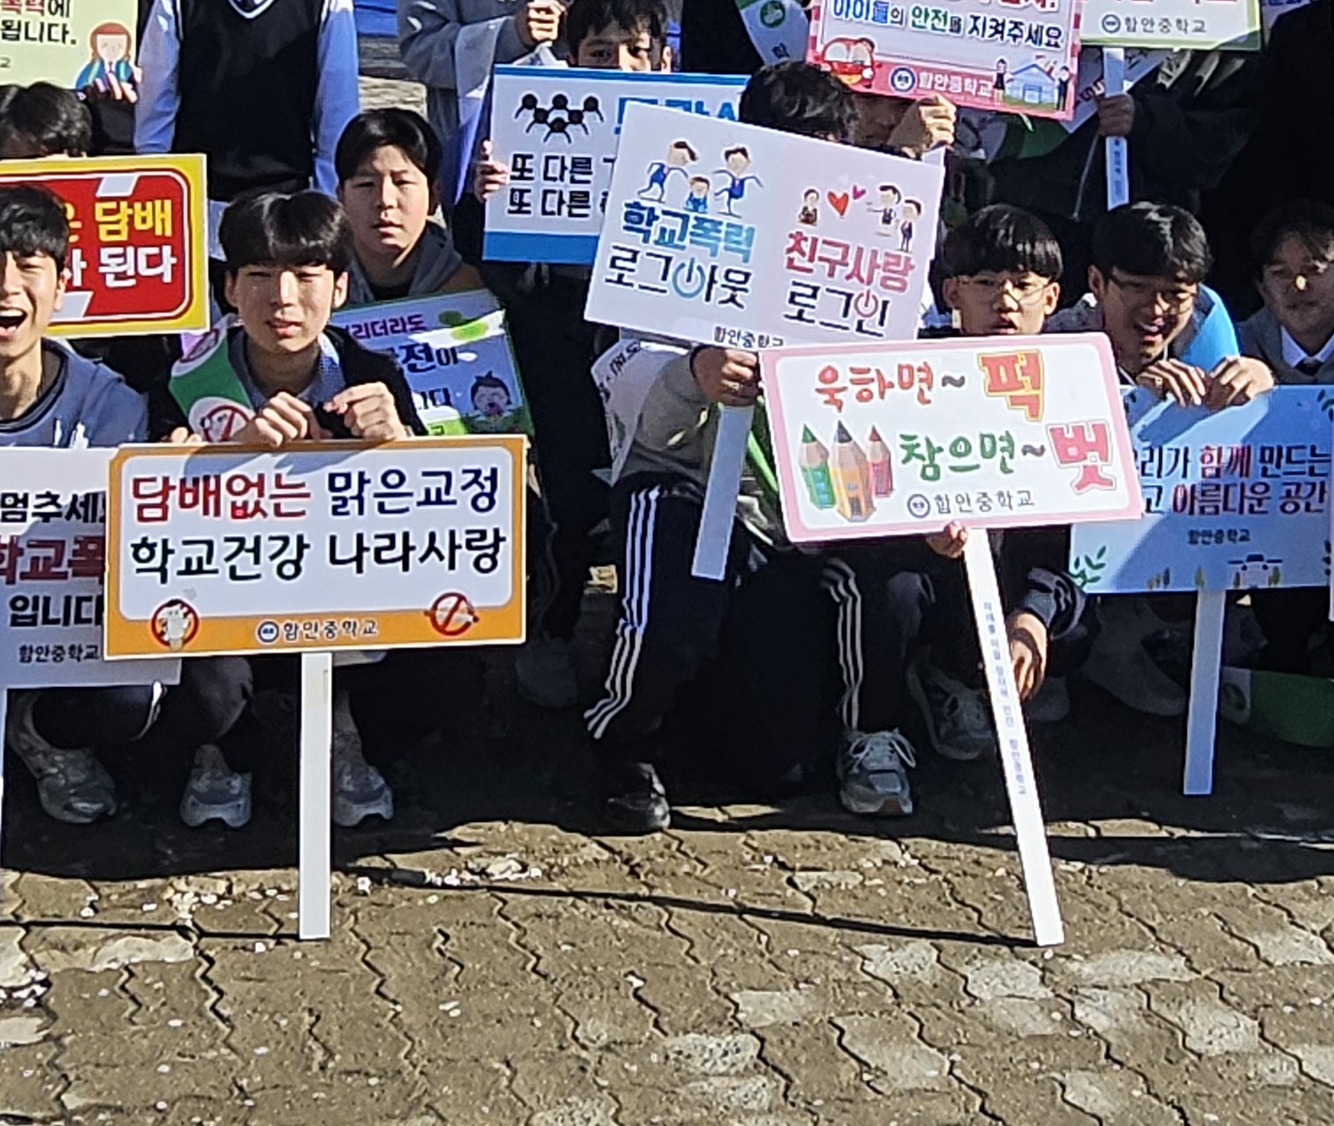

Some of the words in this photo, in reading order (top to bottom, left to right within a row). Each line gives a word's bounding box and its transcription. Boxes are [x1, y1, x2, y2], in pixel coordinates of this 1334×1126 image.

[968, 15, 1063, 50] 지켜주세요
[1125, 16, 1207, 35] 함안중학교
[918, 70, 994, 97] 함안중학교
[510, 153, 535, 182] 또
[543, 154, 594, 184] 다른
[94, 198, 173, 242] 담배
[507, 188, 532, 215] 또
[541, 189, 591, 218] 다른
[622, 200, 756, 264] 학교폭력
[97, 245, 177, 287] 된다
[604, 245, 753, 310] 로그아웃
[785, 230, 915, 294] 친구사랑
[346, 312, 427, 338] 리더라도
[782, 279, 891, 338] 로그인
[980, 351, 1043, 420] 퍽
[1048, 420, 1115, 492] 벗
[1199, 445, 1252, 479] 함께
[1259, 445, 1331, 479] 만드는
[131, 473, 312, 524] 담배없는
[327, 467, 499, 517] 맑은교정
[936, 490, 1036, 515] 함안중학교
[1172, 481, 1271, 516] 아름다운
[1278, 481, 1327, 514] 공간
[130, 533, 310, 585] 학교건강
[328, 527, 507, 575] 나라사랑
[282, 618, 378, 642] 함안중학교
[19, 644, 101, 664] 함안중학교
